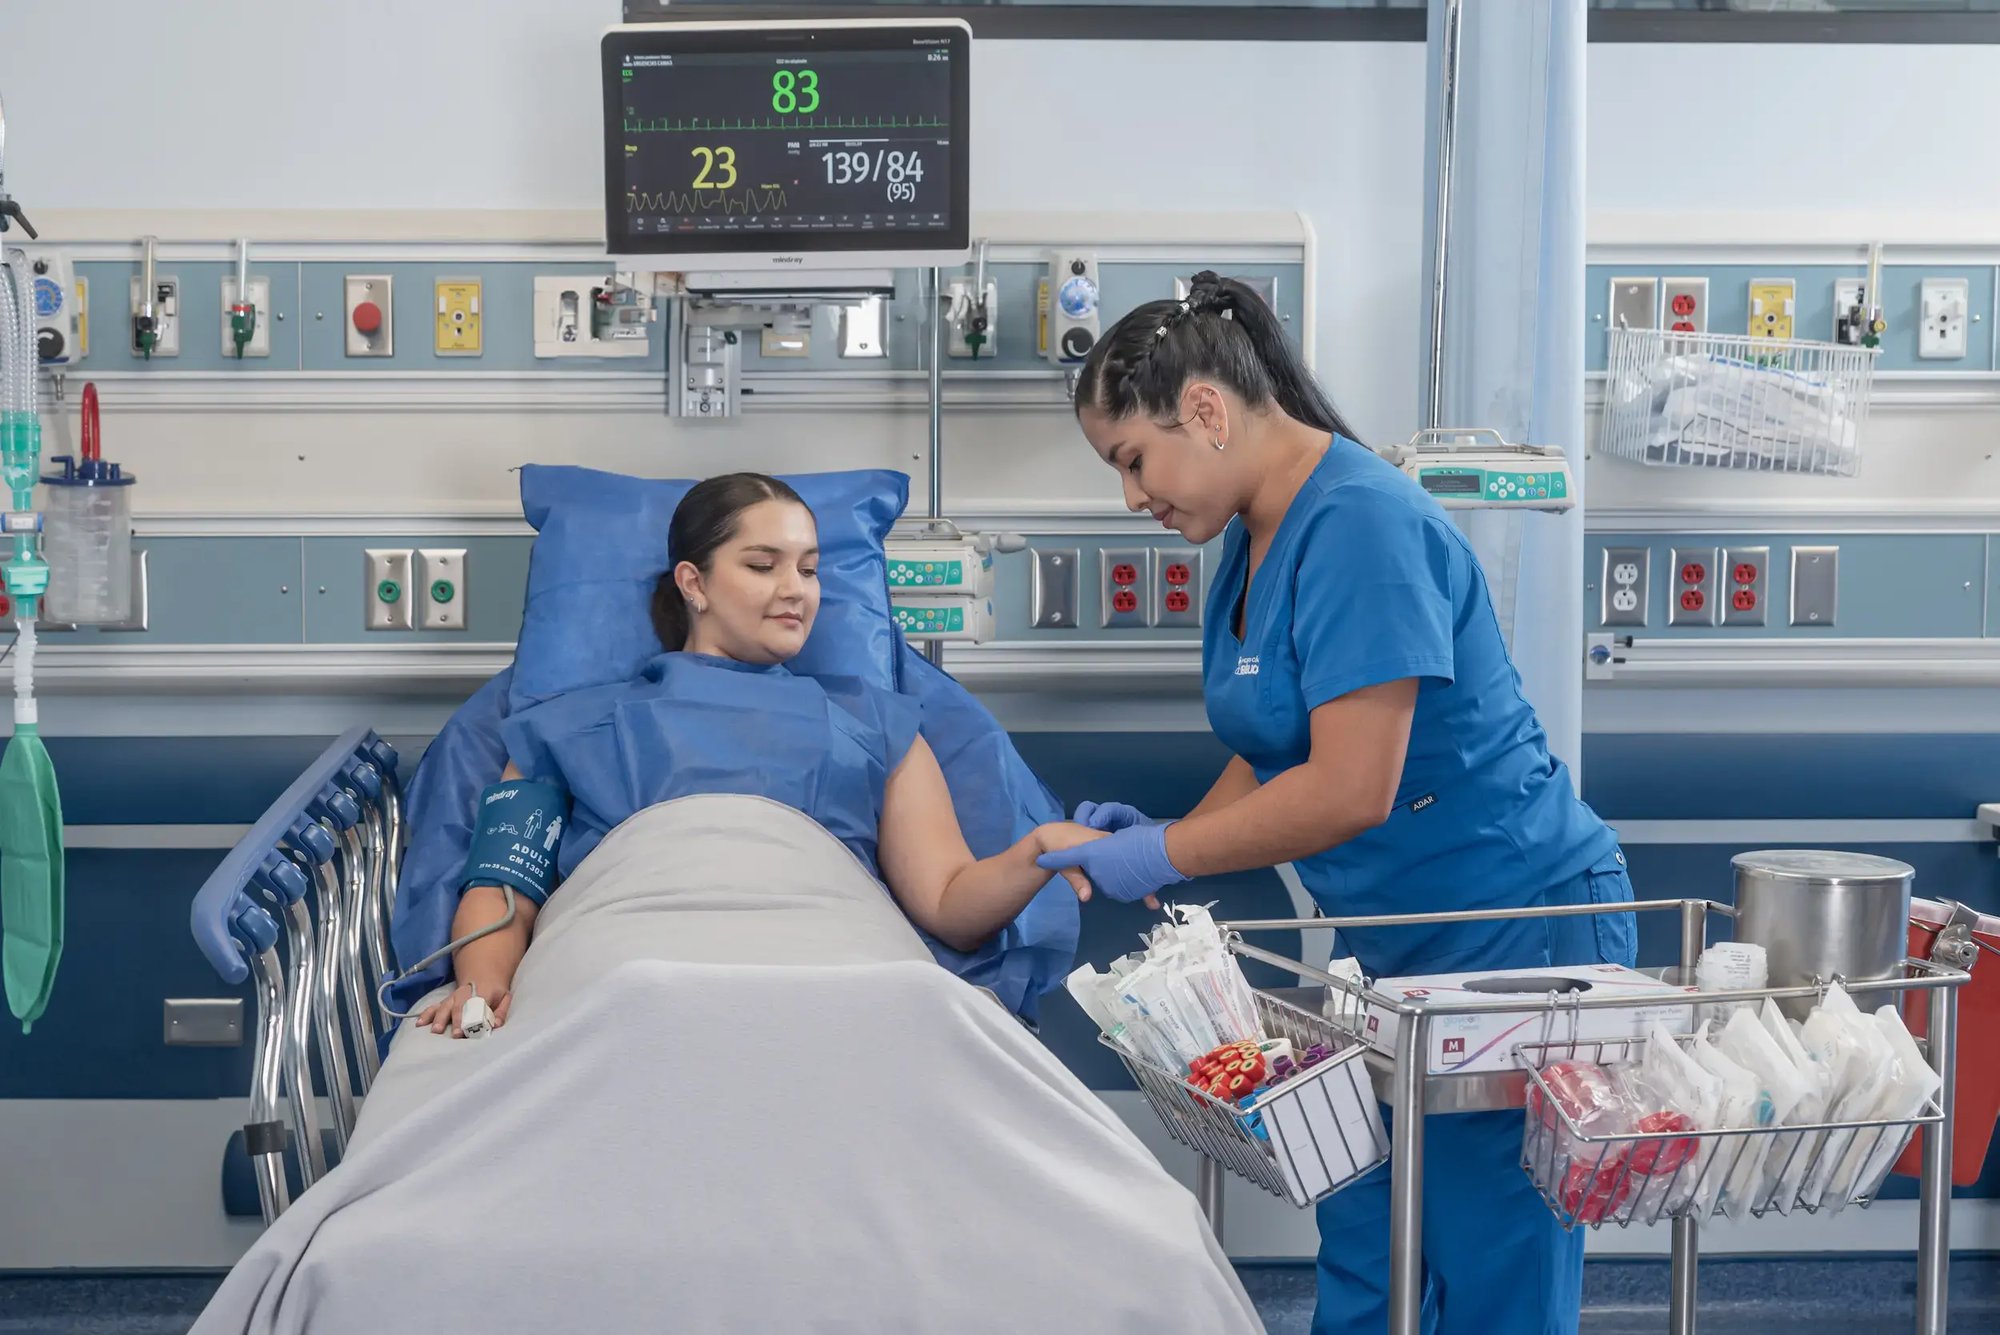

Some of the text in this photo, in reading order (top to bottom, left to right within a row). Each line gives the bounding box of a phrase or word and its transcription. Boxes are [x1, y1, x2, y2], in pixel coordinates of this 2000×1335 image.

[772, 70, 820, 113] 83
[691, 146, 738, 189] 23
[887, 182, 916, 203] (95)
[772, 256, 804, 265] mindray
[485, 789, 519, 806] mindray
[1413, 795, 1434, 811] ADAR
[511, 843, 551, 868] ADULT
[508, 855, 545, 878] CM 1303
[511, 869, 524, 879] arm
[1448, 1040, 1459, 1052] M
